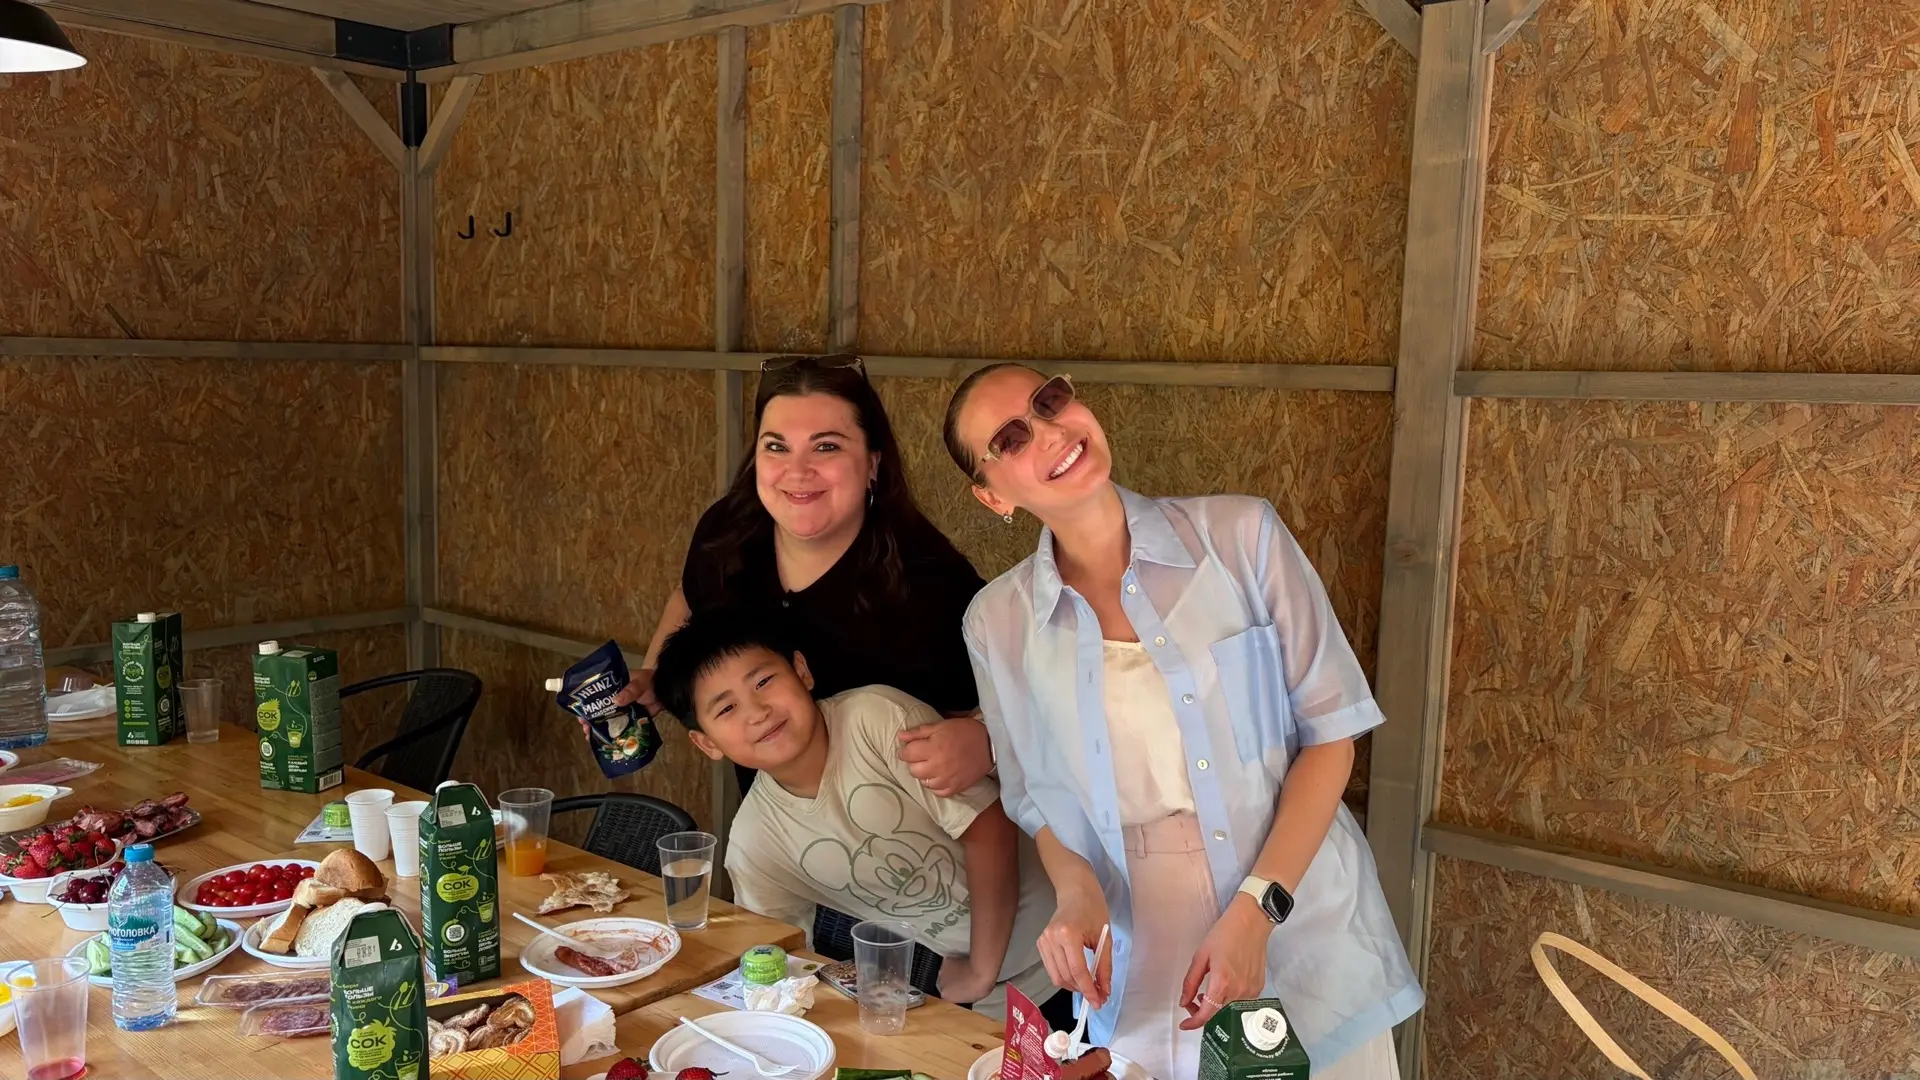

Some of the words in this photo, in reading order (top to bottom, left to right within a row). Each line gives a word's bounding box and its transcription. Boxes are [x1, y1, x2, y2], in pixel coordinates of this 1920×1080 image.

[578, 677, 612, 699] HEINZ
[582, 688, 620, 715] МАЙОН
[258, 711, 278, 720] СОК
[443, 880, 471, 890] СОК
[350, 1035, 387, 1049] СОК
